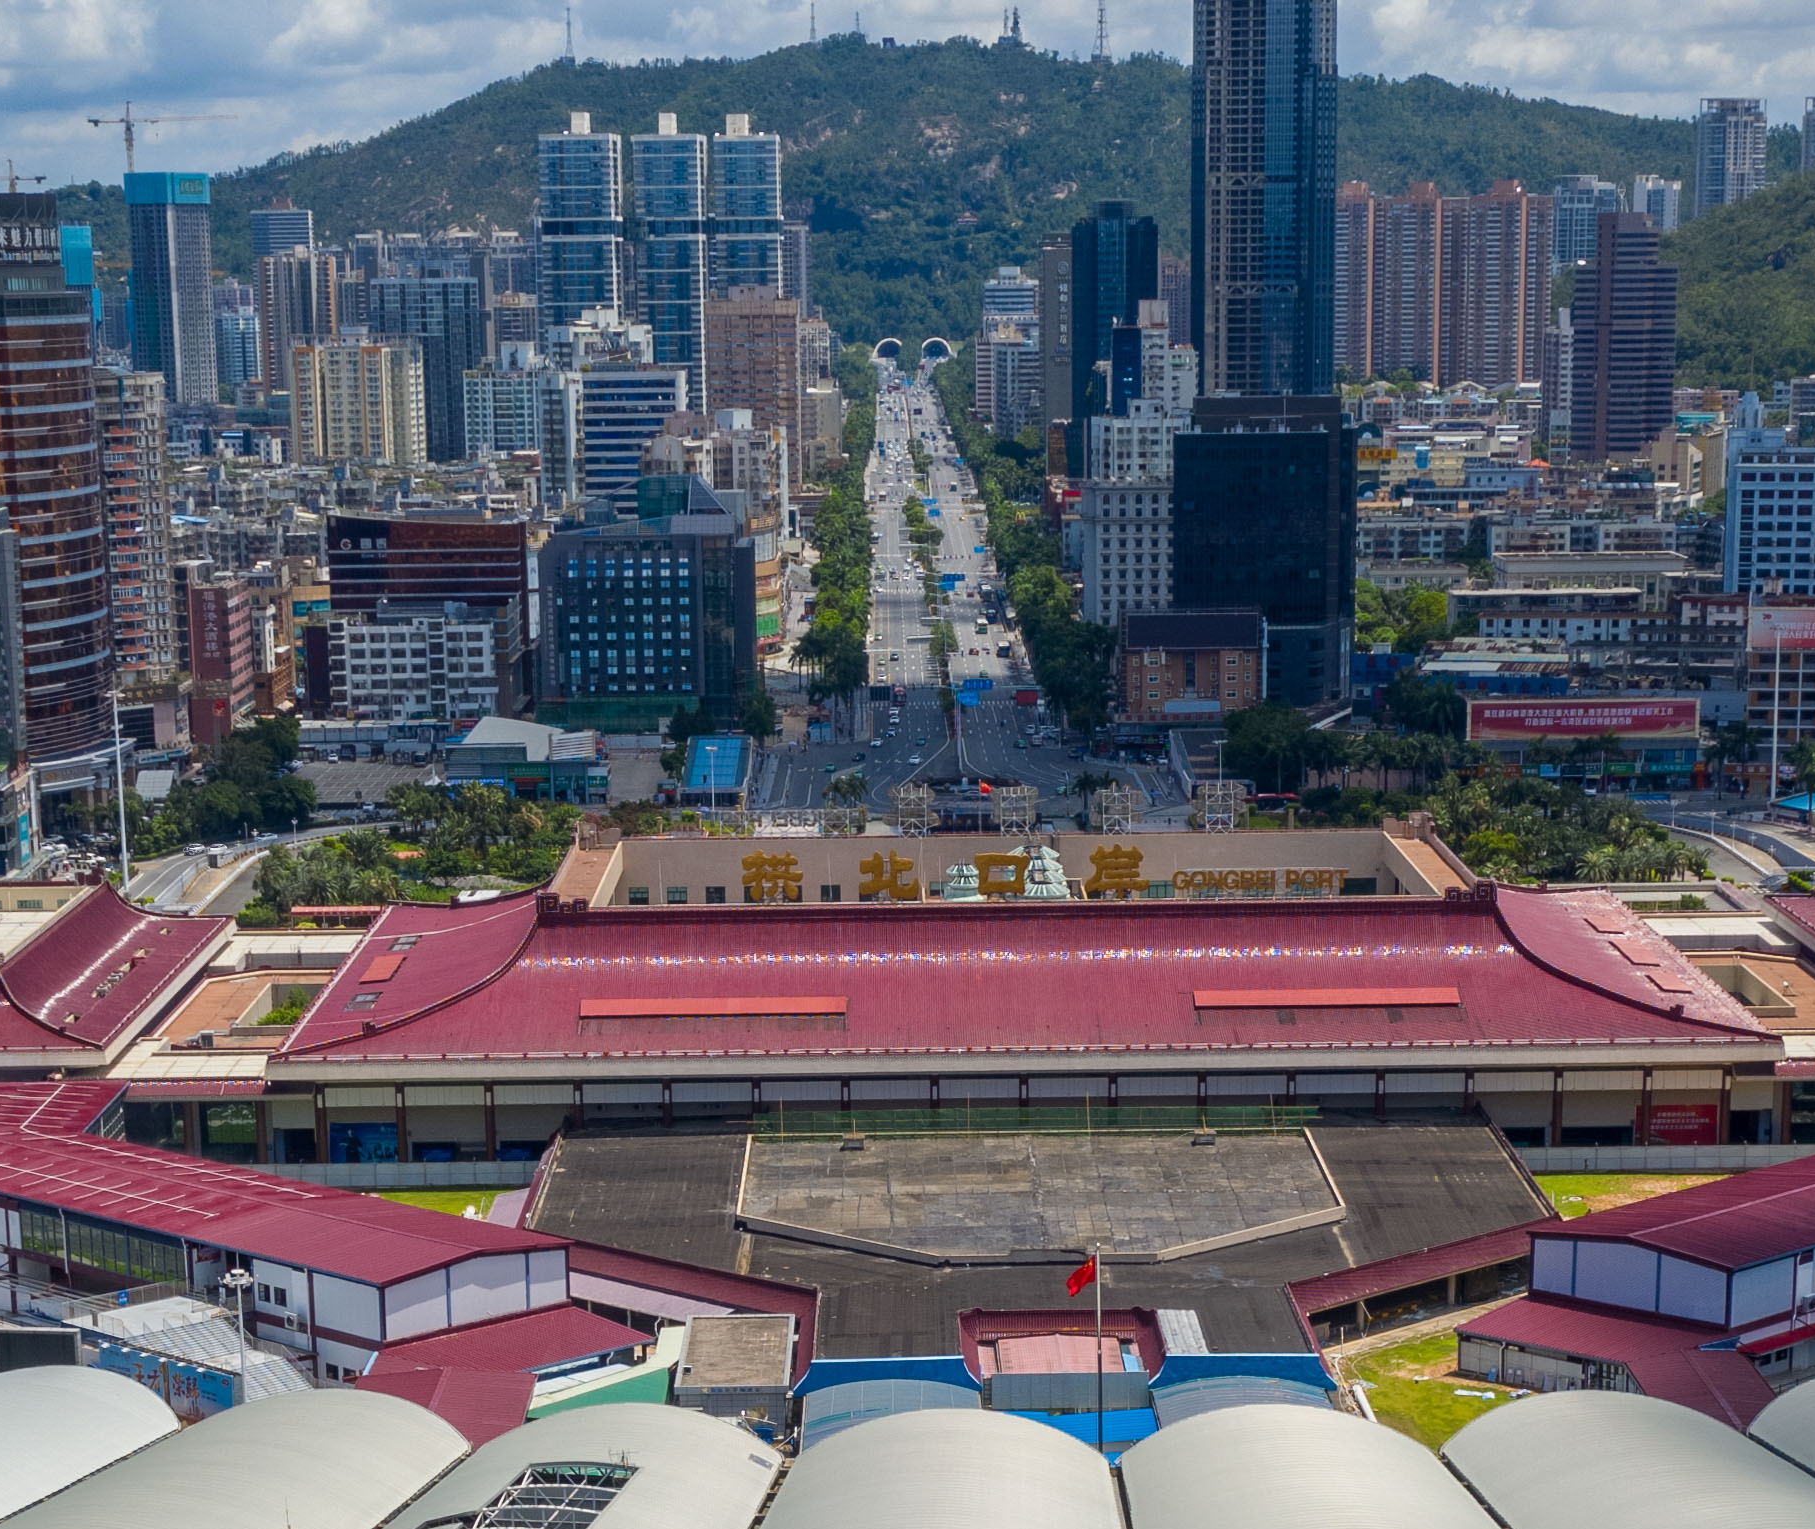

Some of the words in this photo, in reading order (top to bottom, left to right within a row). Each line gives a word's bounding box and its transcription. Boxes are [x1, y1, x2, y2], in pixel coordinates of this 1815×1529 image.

[741, 843, 1150, 901] 拱北口岸
[1172, 869, 1277, 891] GONGBEI
[1285, 867, 1349, 890] PORT
